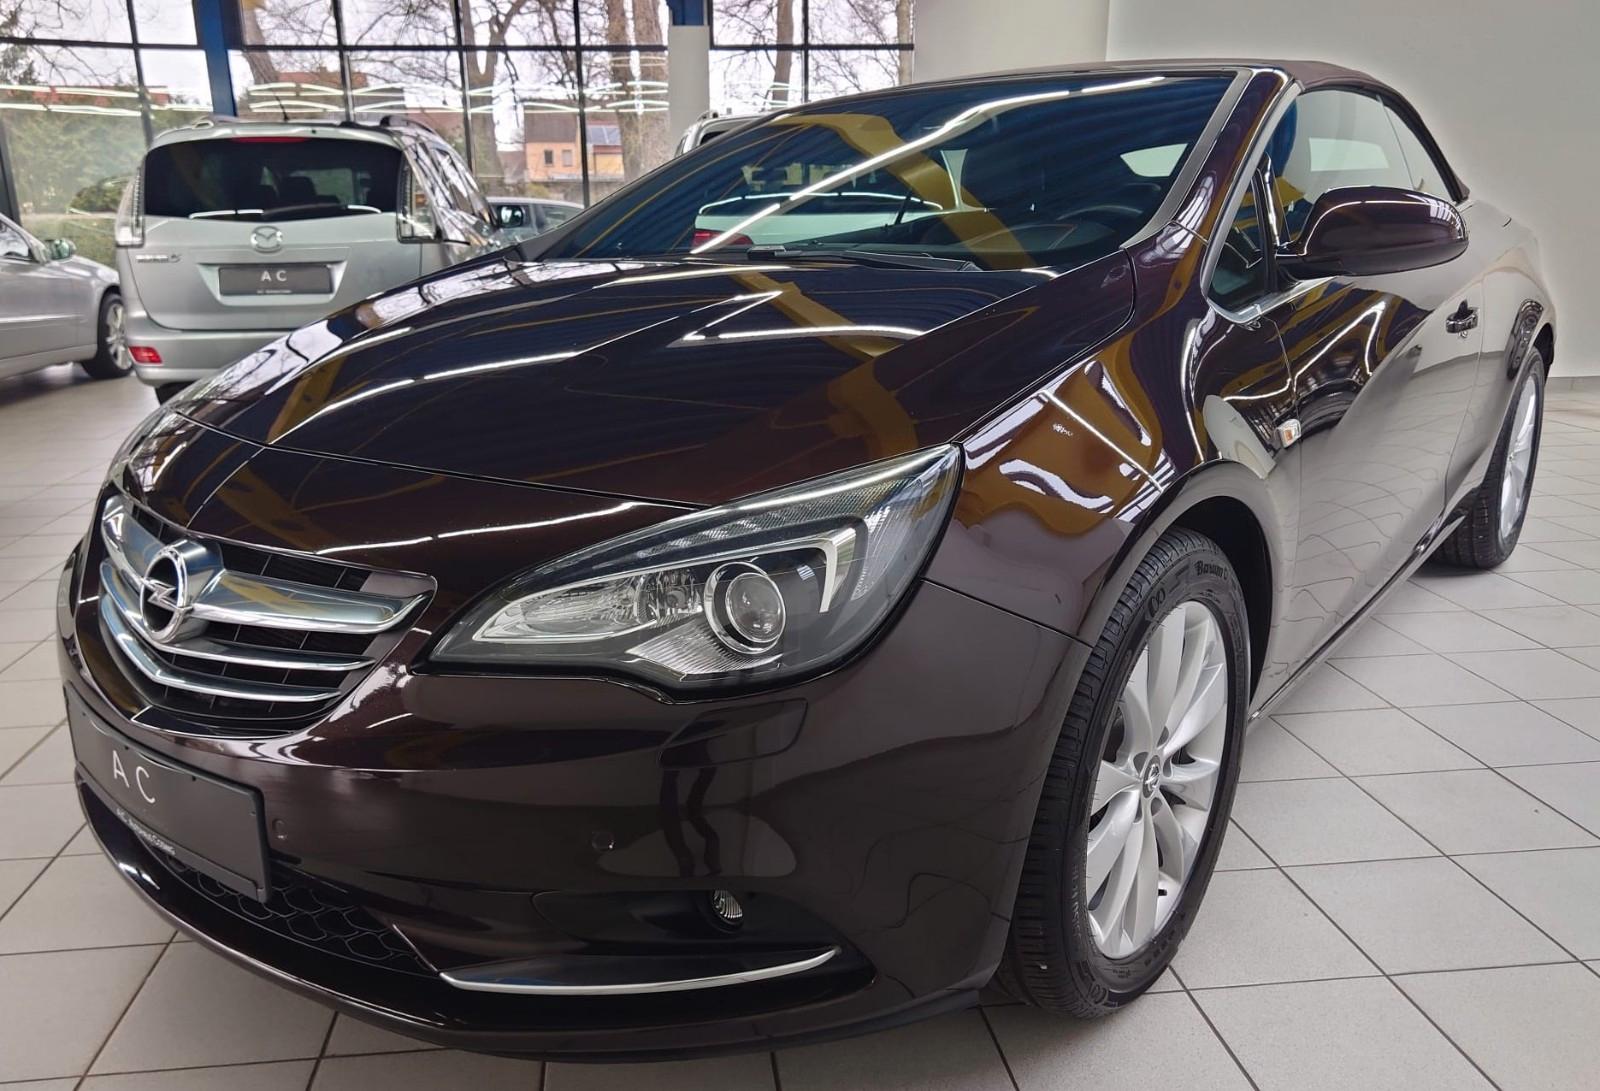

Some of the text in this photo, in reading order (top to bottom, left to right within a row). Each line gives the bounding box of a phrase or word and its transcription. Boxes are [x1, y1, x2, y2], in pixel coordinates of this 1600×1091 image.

[261, 270, 287, 282] A C
[112, 750, 155, 803] A C
